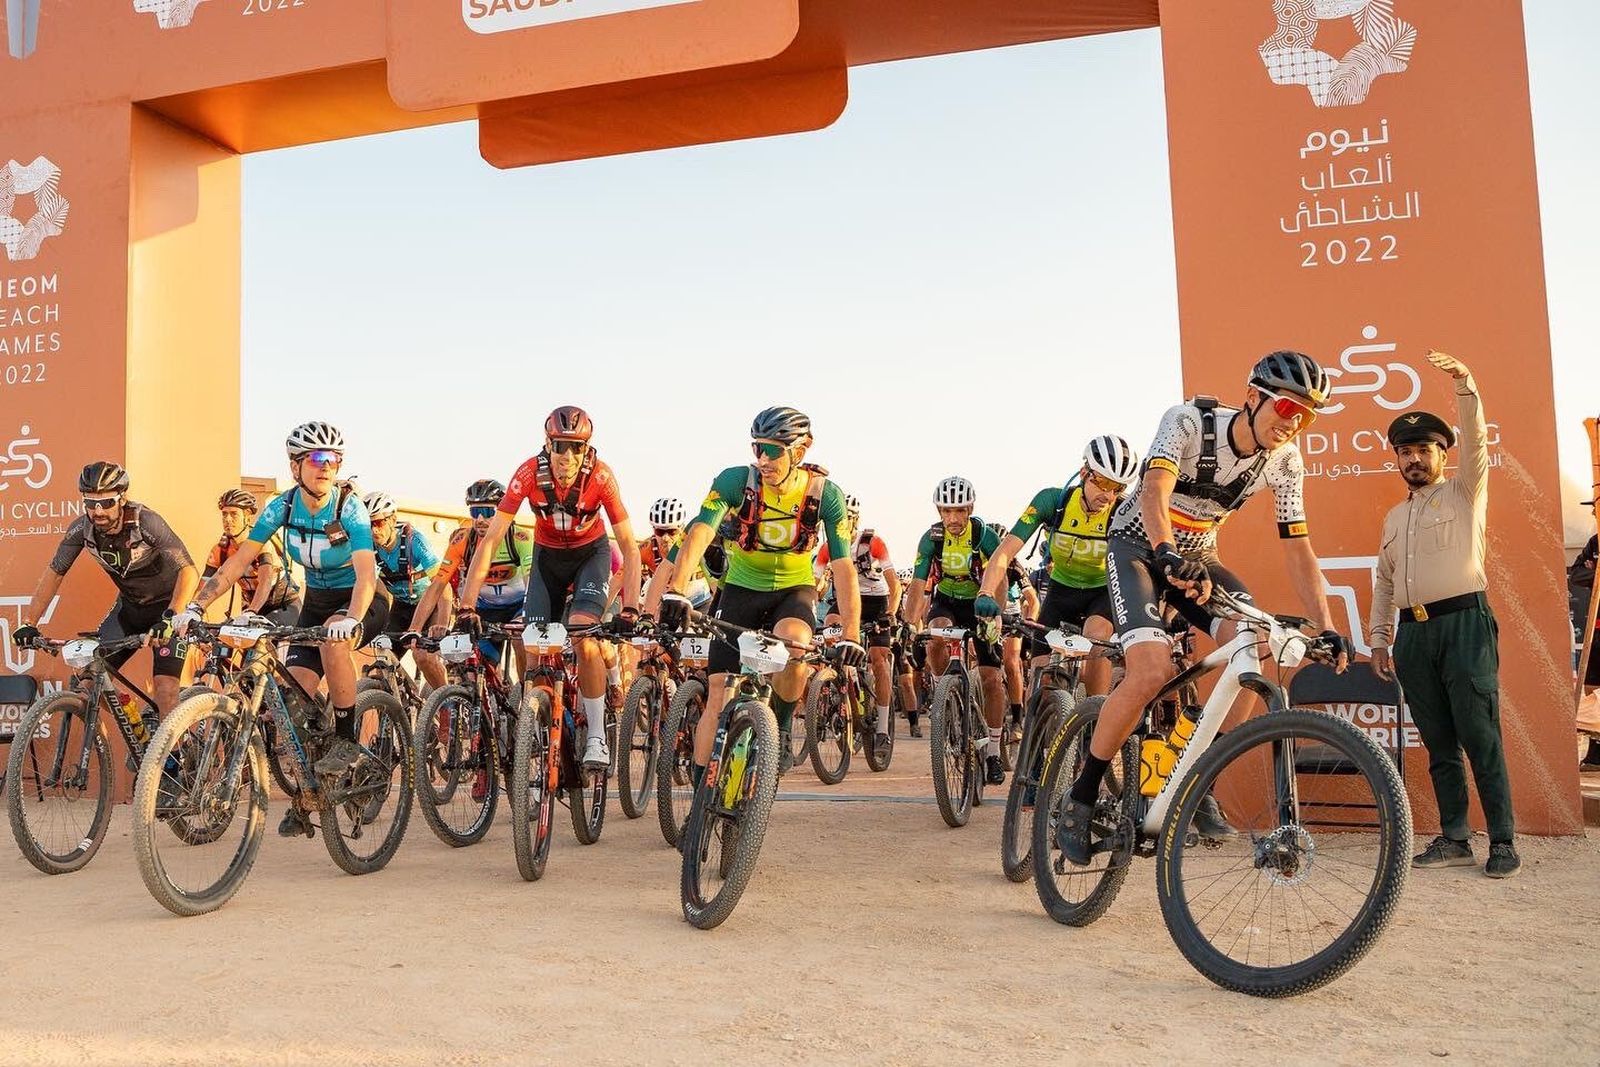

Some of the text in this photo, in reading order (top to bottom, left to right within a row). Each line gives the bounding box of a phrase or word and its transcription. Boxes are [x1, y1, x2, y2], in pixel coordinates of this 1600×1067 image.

[242, 0, 305, 16] 20
[469, 0, 574, 19] SAU
[1300, 119, 1389, 159] نيوم
[1301, 153, 1392, 197] ألعاب
[1300, 235, 1399, 267] 2022
[0, 274, 57, 298] EOM
[0, 363, 46, 384] 022
[1107, 552, 1128, 626] cannondale
[691, 645, 703, 655] 12
[760, 643, 768, 654] 2
[1065, 640, 1073, 648] 6
[1325, 704, 1416, 724] WORL
[1047, 724, 1068, 765] PIRELLI
[1164, 806, 1181, 861] PIRELLI
